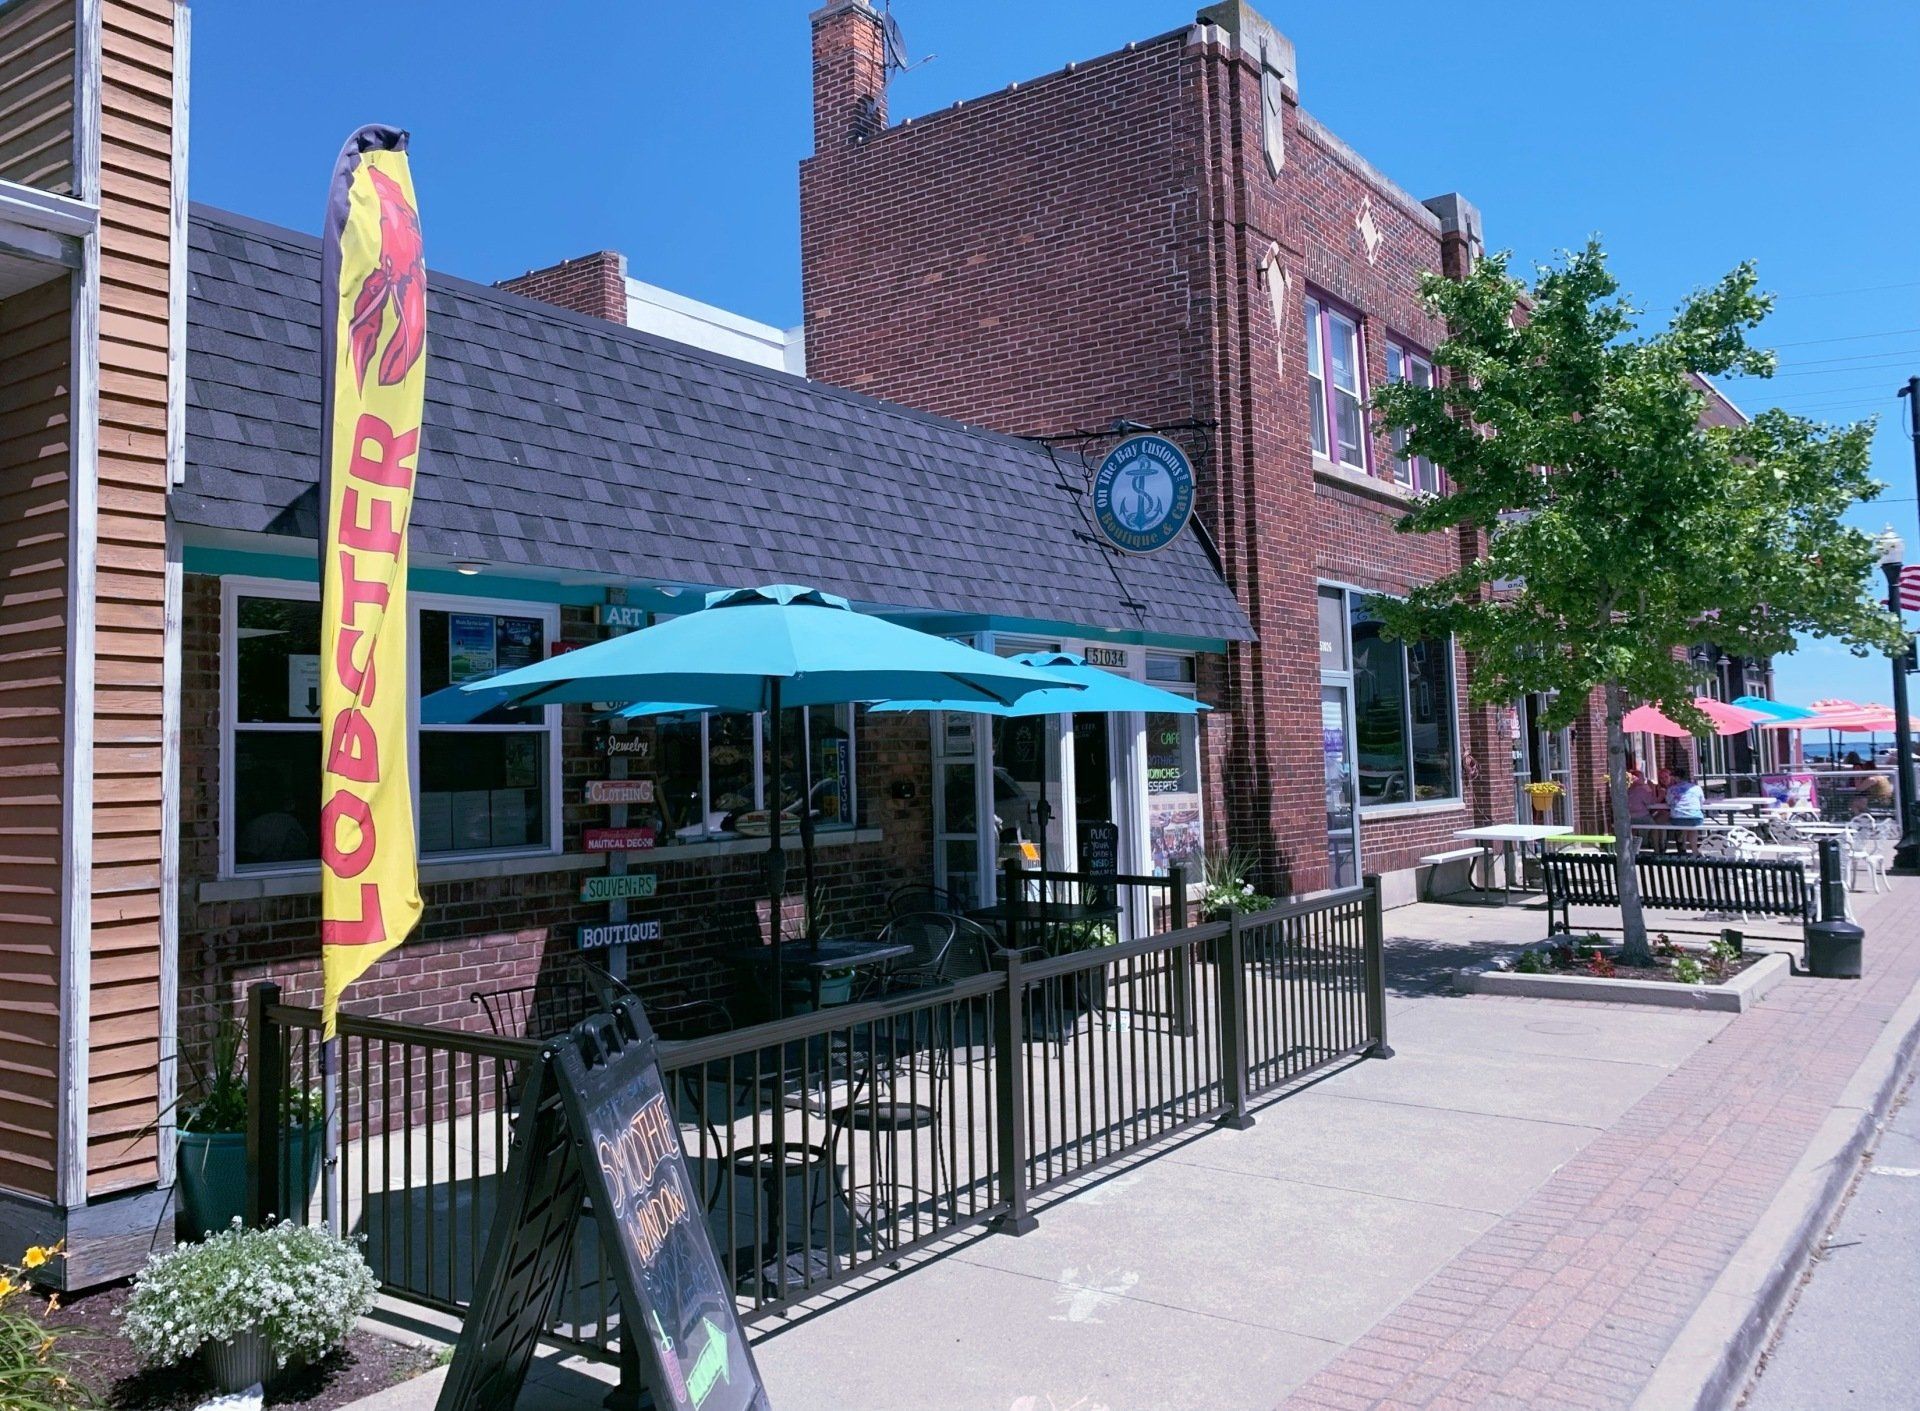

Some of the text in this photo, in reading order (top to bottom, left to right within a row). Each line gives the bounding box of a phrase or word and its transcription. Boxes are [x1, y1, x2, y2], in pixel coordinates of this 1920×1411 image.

[1098, 462, 1117, 485] The
[1115, 443, 1138, 463] Bay
[1141, 440, 1183, 476] Customs
[606, 607, 643, 626] ART
[1092, 650, 1124, 666] 51034
[321, 413, 418, 946] LOBSTER
[607, 735, 649, 757] Jewelry
[591, 782, 651, 802] CLOTHING
[1148, 781, 1178, 792] SSERTS
[588, 839, 625, 849] NAUTICAL
[583, 921, 658, 948] BOUTIQUE
[598, 1097, 679, 1209] SMOOTHIE
[627, 1180, 687, 1265] WINDOW
